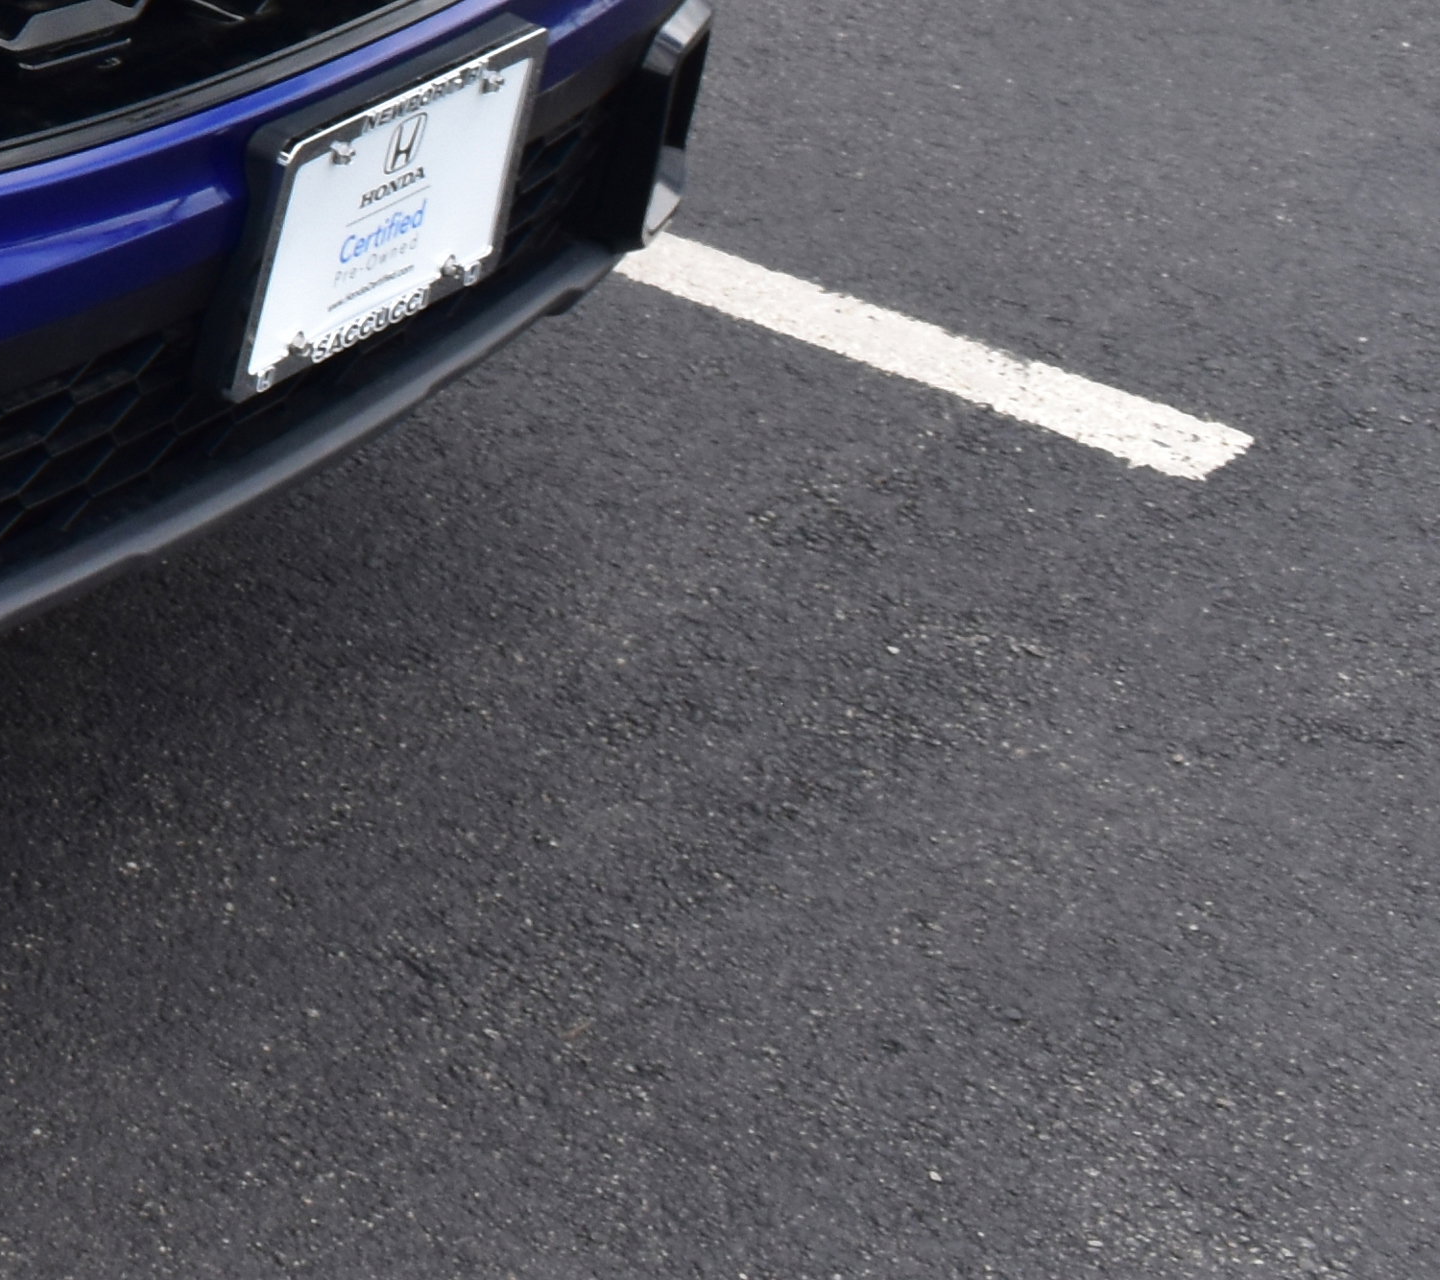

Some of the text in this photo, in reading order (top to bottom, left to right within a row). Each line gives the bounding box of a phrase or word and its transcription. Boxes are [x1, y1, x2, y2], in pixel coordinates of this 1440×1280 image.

[359, 165, 426, 209] HONDA
[338, 198, 428, 264] Certified
[332, 237, 420, 289] Pre-Owned
[312, 286, 432, 364] SACCUCCI
